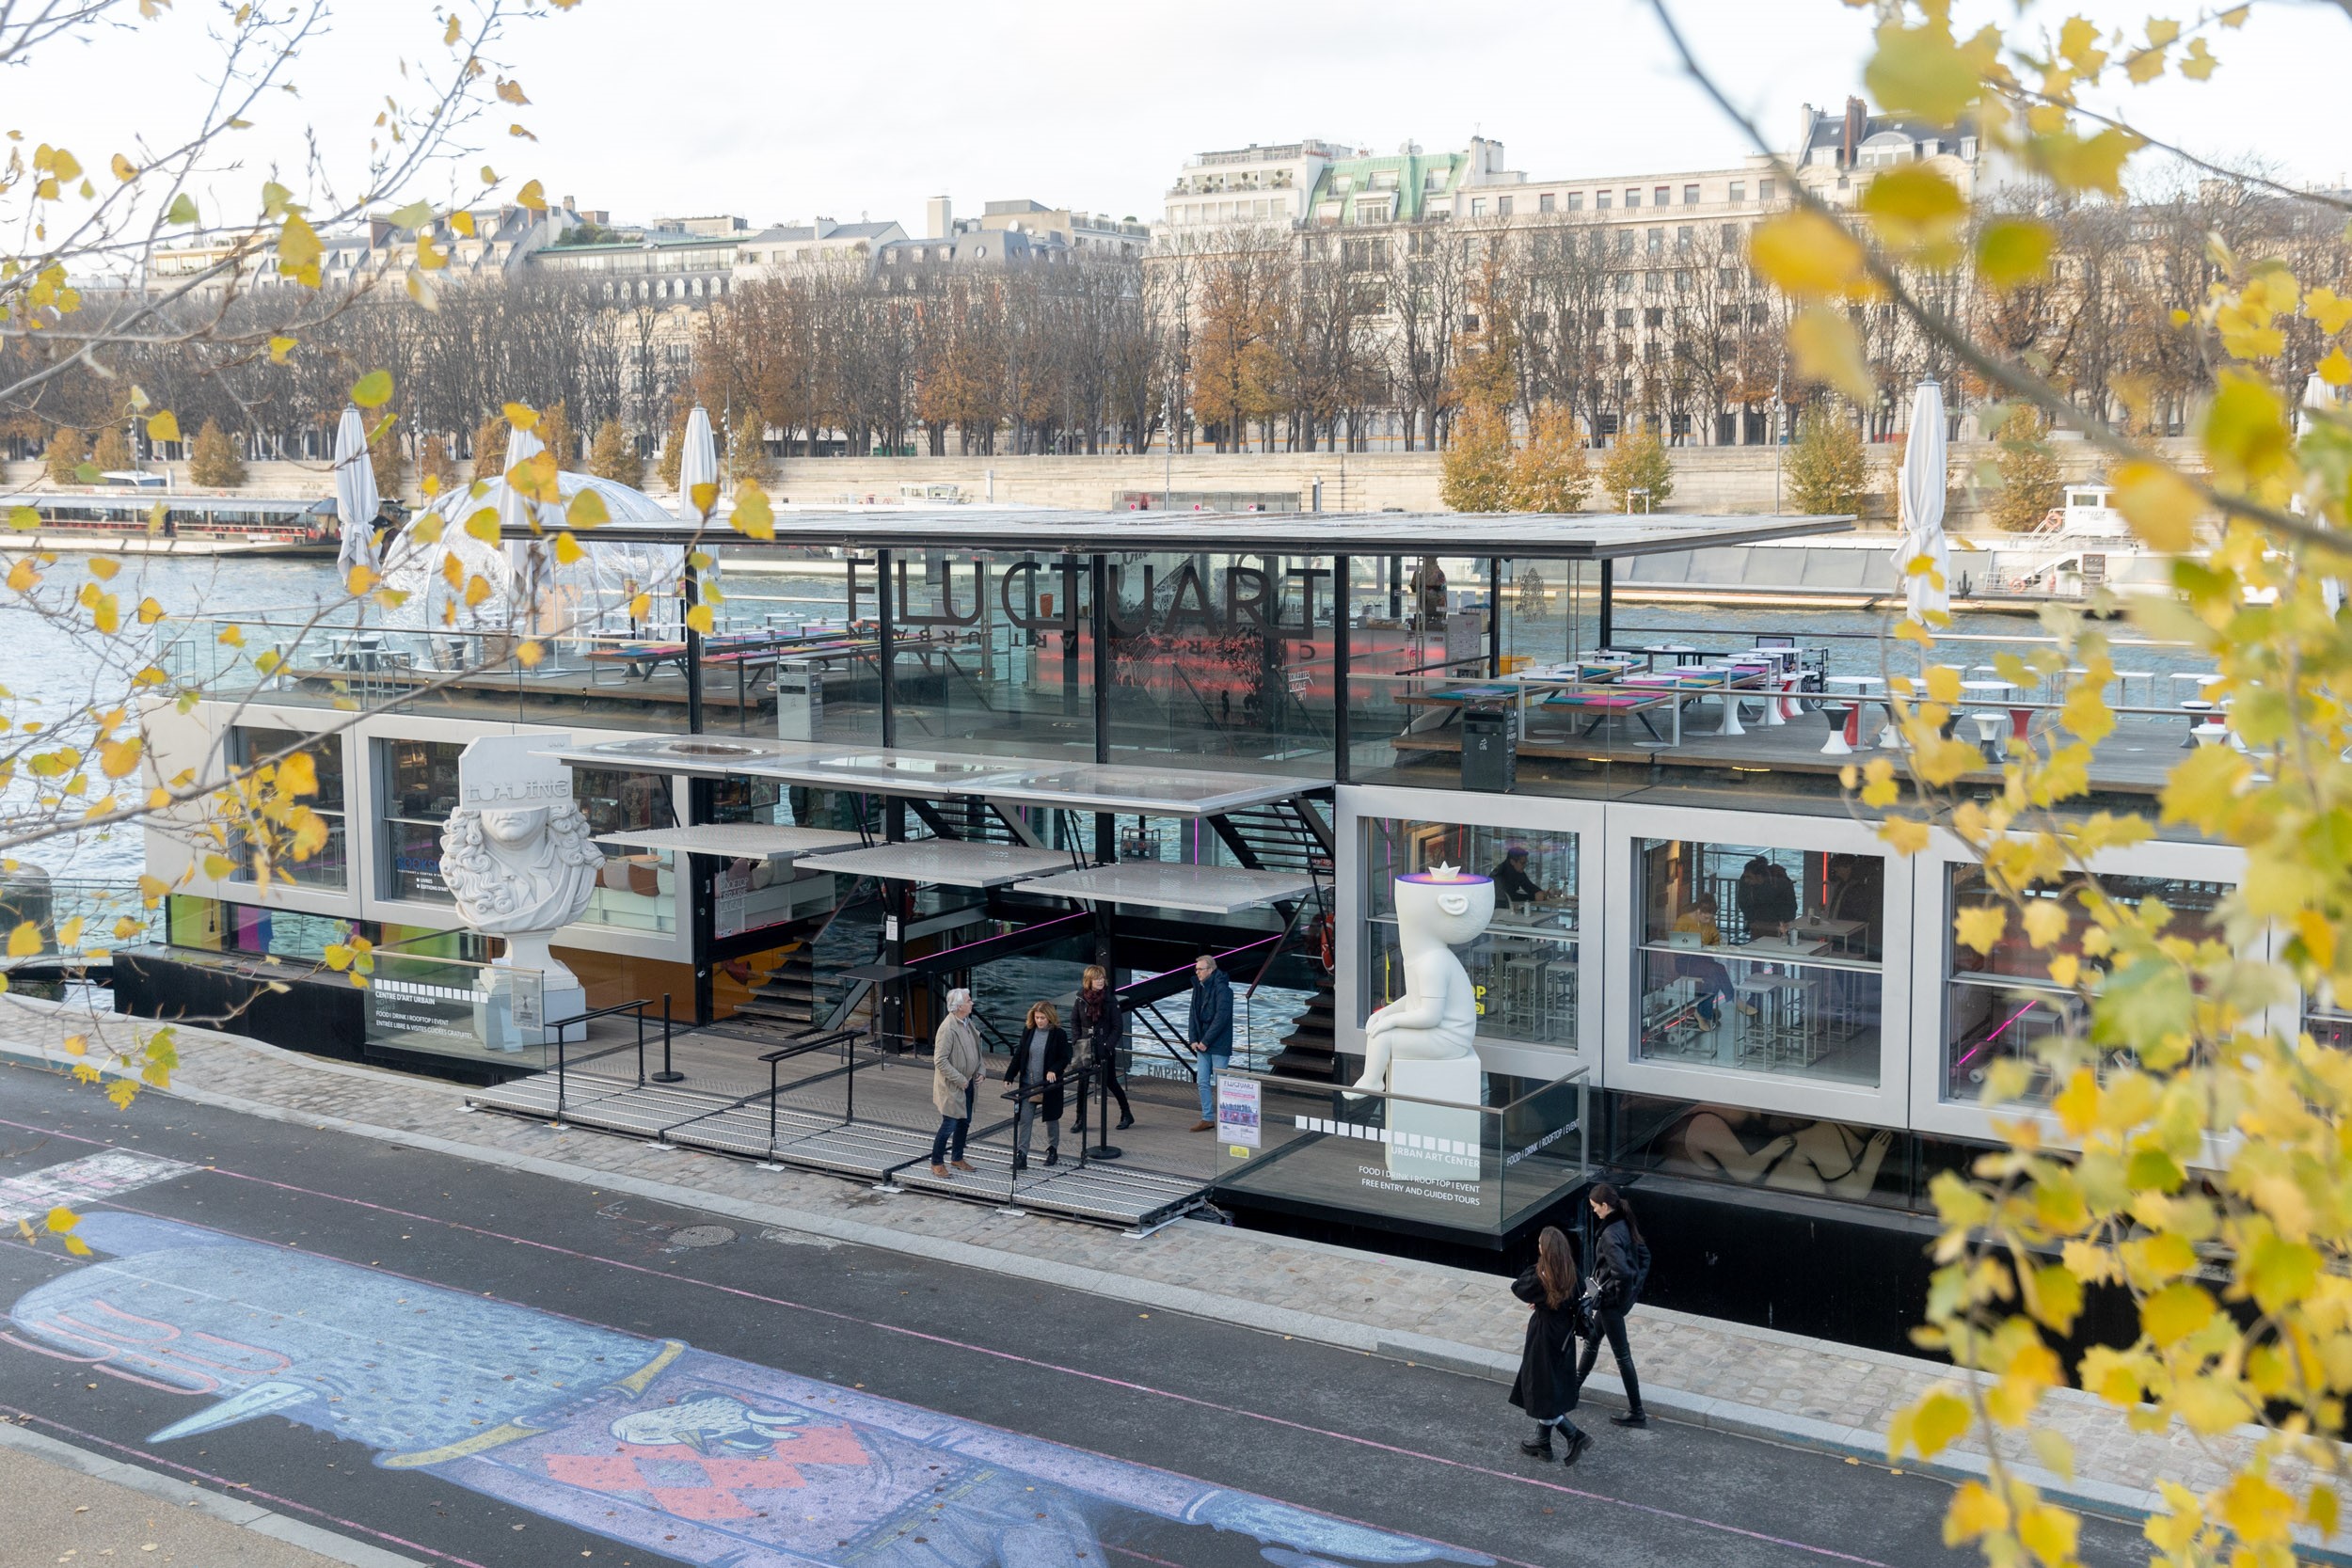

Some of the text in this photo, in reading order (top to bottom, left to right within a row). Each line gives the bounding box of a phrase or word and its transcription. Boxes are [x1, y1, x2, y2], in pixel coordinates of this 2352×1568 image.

[846, 558, 1330, 641] FLUCTUART
[466, 780, 570, 802] LOADING
[375, 990, 436, 1006] CENTRE D'ART URBAIN
[409, 1015, 431, 1023] ROOFTOP
[434, 1018, 449, 1026] EVENT
[1148, 1064, 1194, 1084] EMPREI
[1506, 1151, 1521, 1166] FOOD
[1524, 1141, 1538, 1157] DRINK
[1542, 1128, 1562, 1148] ROOFTOP
[1565, 1117, 1581, 1133] EVENT
[1391, 1146, 1480, 1168] URBAN ART CENTER
[1359, 1165, 1381, 1177] FOOD
[1386, 1170, 1408, 1181] DRINK
[1414, 1174, 1451, 1188] ROOFTOP
[1455, 1181, 1480, 1194] EVENT
[1361, 1178, 1480, 1206] FREE ENTRY AND GUIDED TOURS
